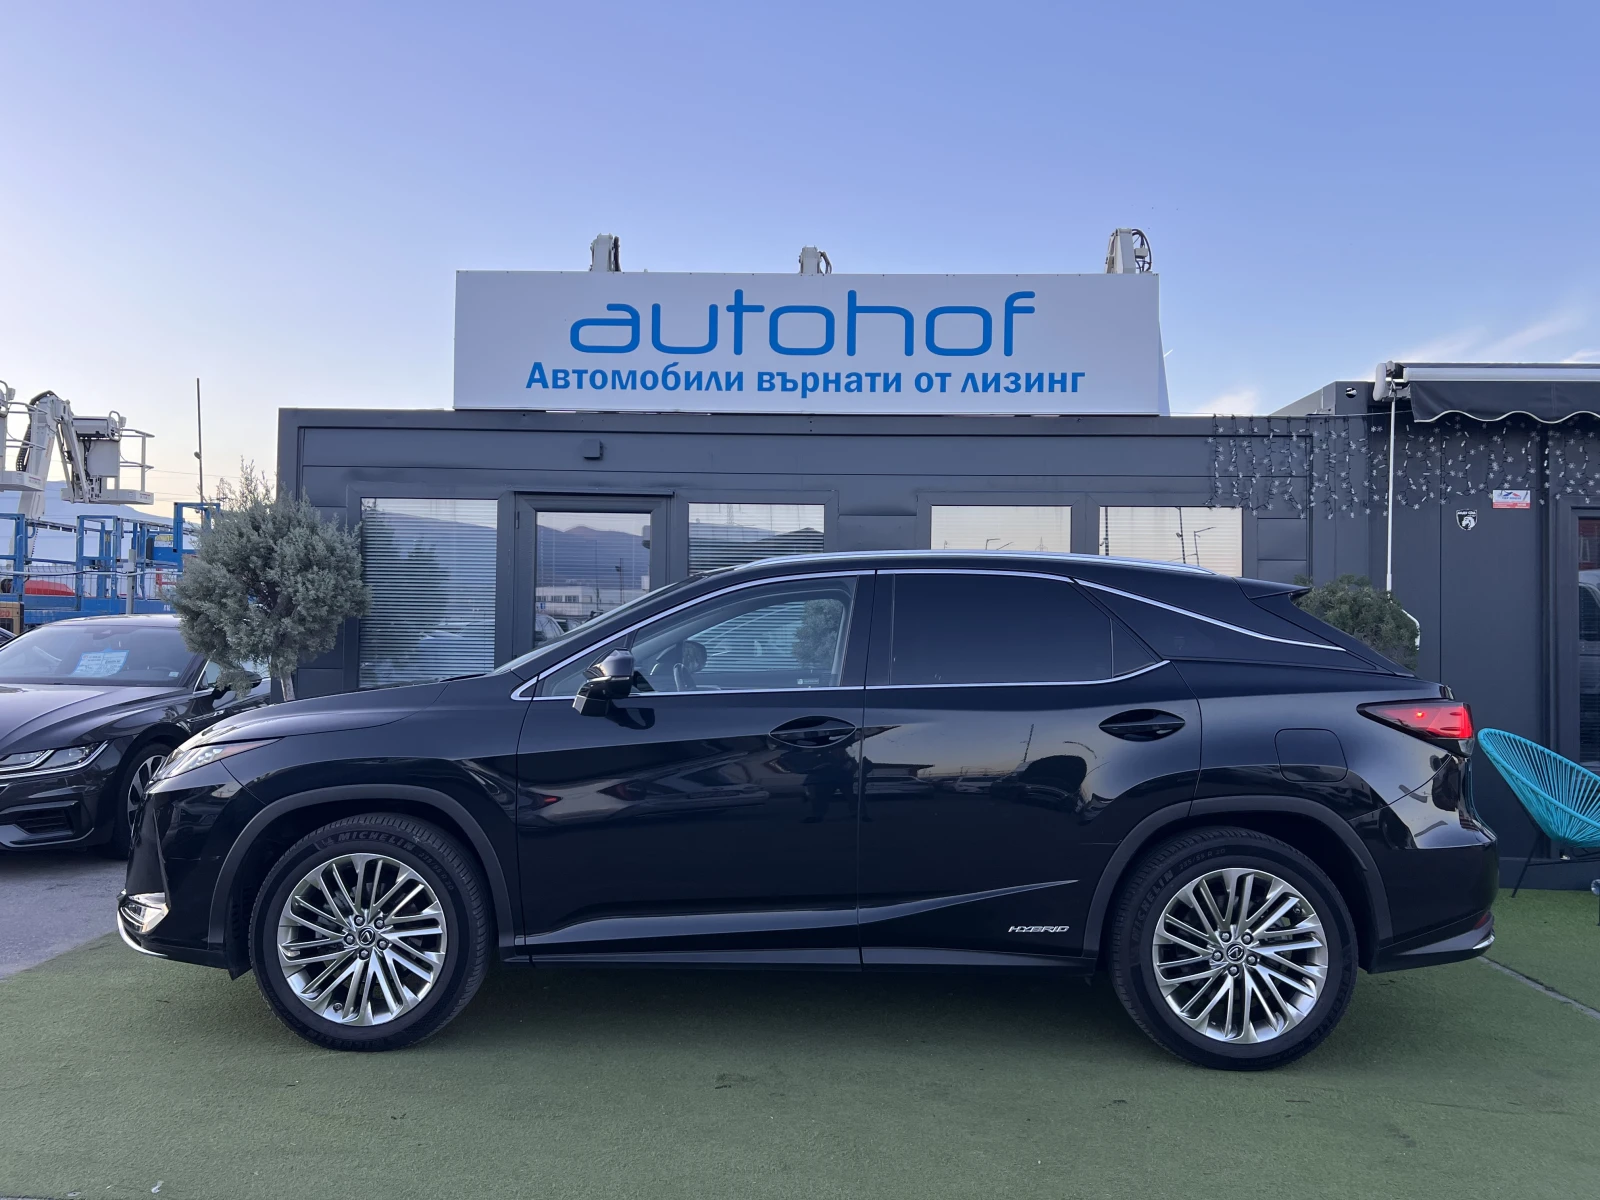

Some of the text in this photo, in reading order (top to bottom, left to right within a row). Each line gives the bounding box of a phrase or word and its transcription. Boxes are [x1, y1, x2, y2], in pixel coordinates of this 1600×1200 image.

[570, 289, 1036, 357] autohof
[525, 361, 1086, 399] Автомобили върнати от лизинг
[338, 830, 414, 850] MICHELIN
[1131, 870, 1174, 942] MICHELIN
